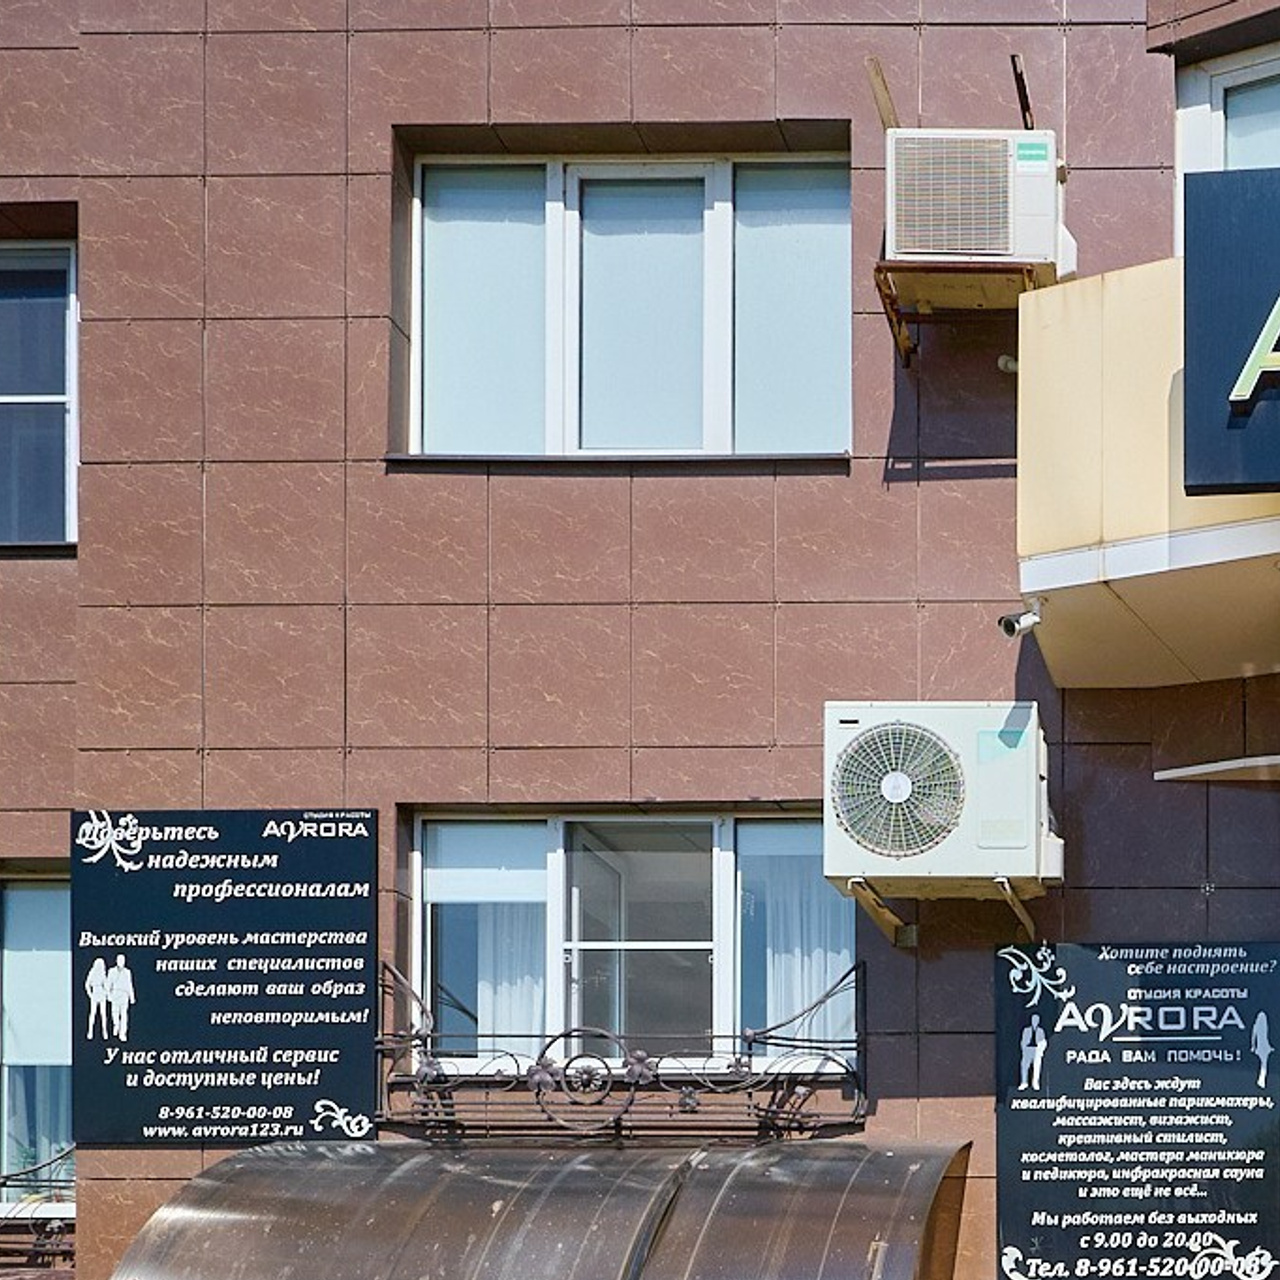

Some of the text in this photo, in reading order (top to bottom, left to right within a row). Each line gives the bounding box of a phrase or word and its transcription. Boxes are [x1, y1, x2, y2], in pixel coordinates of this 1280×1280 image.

[261, 820, 369, 843] AVRORA
[147, 850, 279, 869] надежным
[173, 879, 370, 903] профессионалам
[78, 930, 368, 950] Высокий уровень мастерства
[1098, 944, 1248, 961] Хотите поднять
[156, 957, 365, 974] наших специалистов
[1127, 960, 1278, 977] себе настроение?
[175, 979, 366, 998] сделают ваш образ
[1184, 987, 1249, 999] КРАСОТЫ
[210, 1008, 370, 1028] неповторимым!
[1054, 1002, 1246, 1042] AVRORA
[103, 1046, 340, 1067] У нас отличный сервис
[1066, 1049, 1243, 1064] РАДА ВАМ ПОМОЧЬ!
[126, 1068, 321, 1091] и доступные цены!
[1084, 1076, 1202, 1092] Вас здесь ждут
[1011, 1095, 1275, 1112] квалифицированные парикмахеры,
[158, 1106, 294, 1120] 8-961-520-00-08
[1052, 1114, 1234, 1127] массажист, визажист,
[1058, 1131, 1228, 1147] креативный стилист,
[1021, 1150, 1266, 1164] косметолог, мастера маникюра
[1022, 1165, 1265, 1182] и педикюра, инфракрасная сауна
[1078, 1187, 1089, 1198] и
[1090, 1186, 1121, 1198] это
[1122, 1184, 1152, 1199] ещё
[1153, 1186, 1172, 1198] не
[1031, 1209, 1258, 1228] Мы работаем без выходных
[1079, 1230, 1215, 1250] с 9.00 до 20.00
[1025, 1258, 1071, 1278] Тел.
